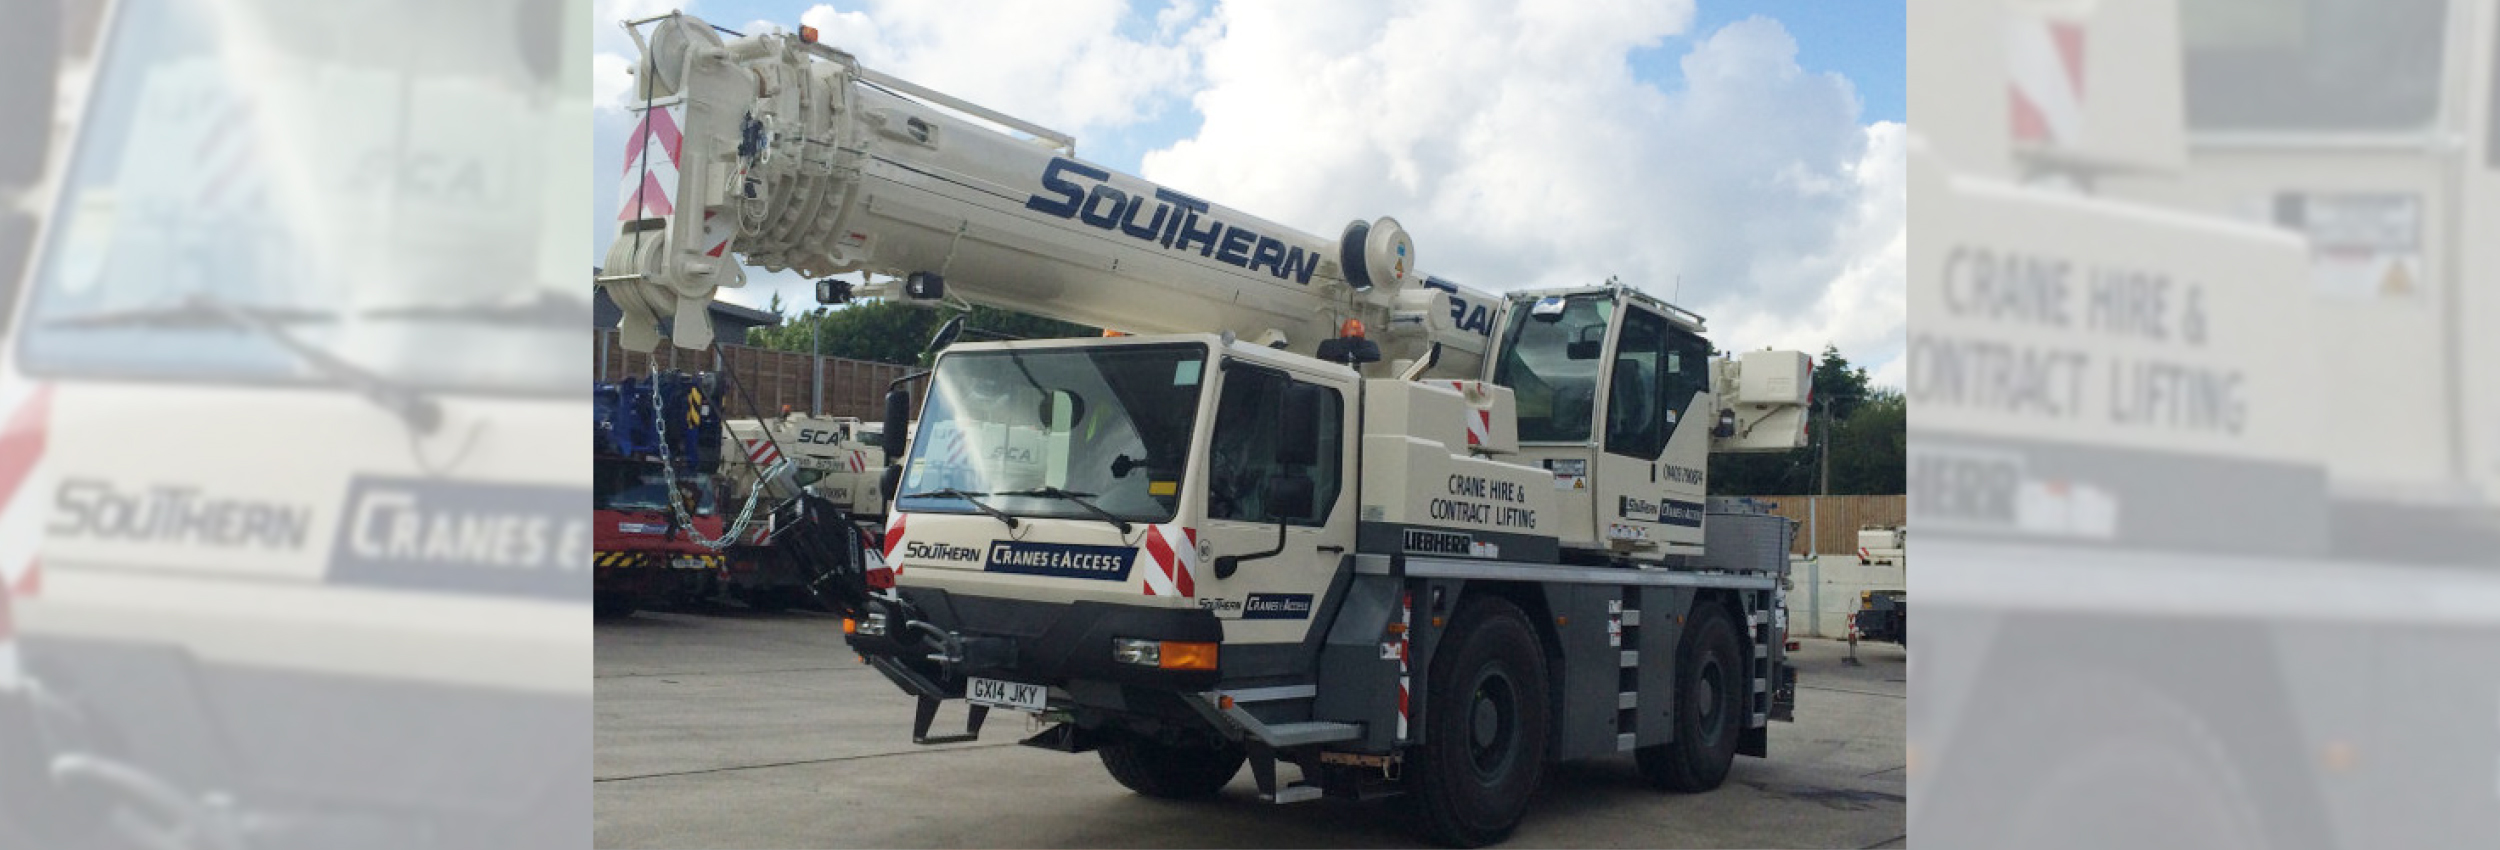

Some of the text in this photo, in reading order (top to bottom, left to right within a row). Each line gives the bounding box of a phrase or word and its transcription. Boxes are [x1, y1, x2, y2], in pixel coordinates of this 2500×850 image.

[1025, 156, 1320, 285] SOUTHERN
[1943, 244, 2072, 330] CRANE
[2087, 265, 2169, 342] HIRE
[1905, 333, 2248, 436] ONTRACT LIFTING
[798, 428, 839, 446] SCA
[1449, 474, 1525, 503] CRANE HIRE &
[46, 480, 312, 550] SOUTHERN
[351, 490, 548, 568] CRANES
[1430, 498, 1536, 529] CONTRACT LIFTING
[904, 541, 981, 562] SOUTHERN
[992, 545, 1049, 567] CRANES
[1060, 550, 1122, 572] ACCESS
[1405, 530, 1470, 554] LIEBHERR
[975, 680, 1037, 704] GX14 JKY
